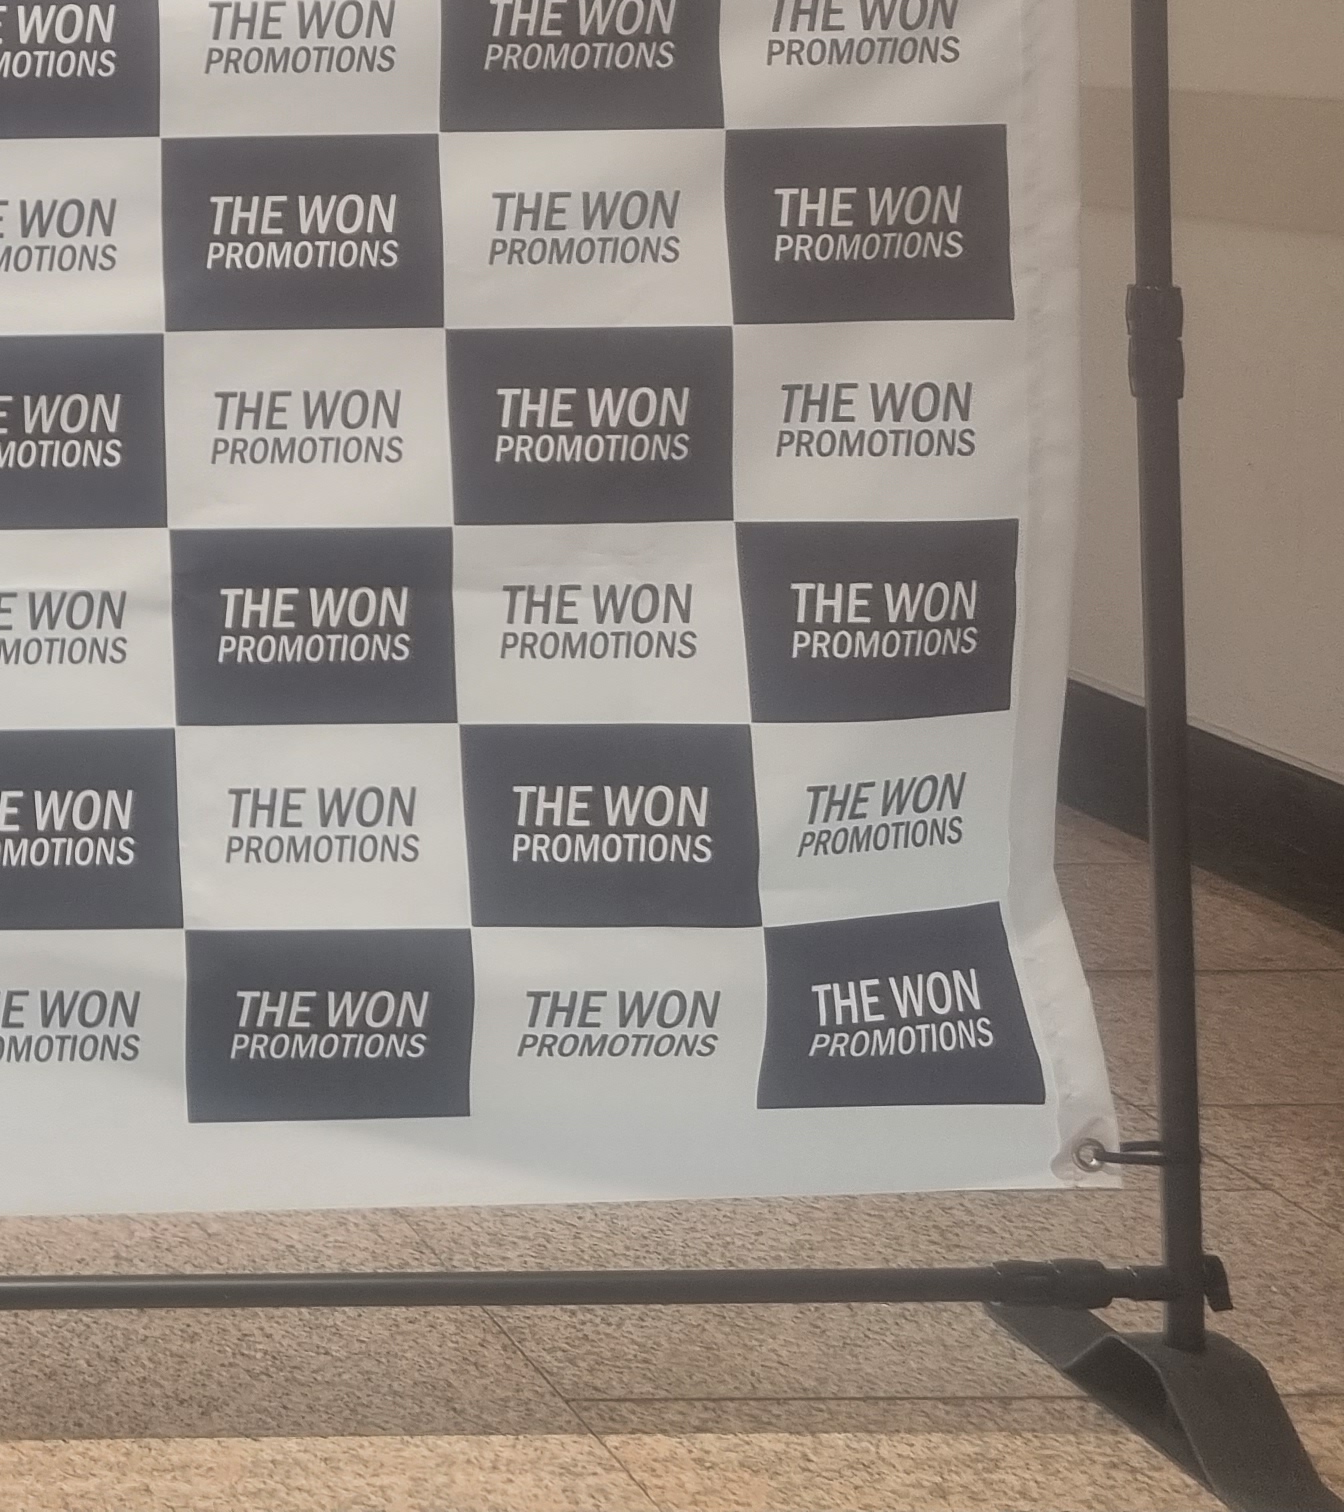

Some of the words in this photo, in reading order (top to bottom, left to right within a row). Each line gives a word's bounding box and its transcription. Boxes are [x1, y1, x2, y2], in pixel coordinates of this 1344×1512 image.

[208, 0, 287, 41] THE
[297, 0, 396, 40] WON
[204, 44, 397, 75] PROMOTIONS
[491, 191, 572, 232] THE
[582, 189, 681, 231] WON
[488, 235, 681, 266] PROMOTIONS
[23, 393, 122, 435] WON
[496, 387, 578, 429] THE
[586, 386, 690, 428] WON
[494, 432, 690, 464] PROMOTIONS
[27, 589, 128, 631] WON
[790, 582, 874, 624] THE
[883, 579, 978, 624] WON
[791, 626, 979, 660] PROMOTIONS
[33, 788, 134, 832] WON
[227, 787, 307, 829] THE
[317, 785, 417, 829] WON
[225, 833, 420, 865] PROMOTIONS
[236, 990, 318, 1029] THE
[327, 990, 430, 1029] WON
[810, 978, 886, 1027] THE
[888, 967, 982, 1019] WON
[229, 1032, 428, 1060] PROMOTIONS
[808, 1016, 995, 1058] PROMOTIONS
